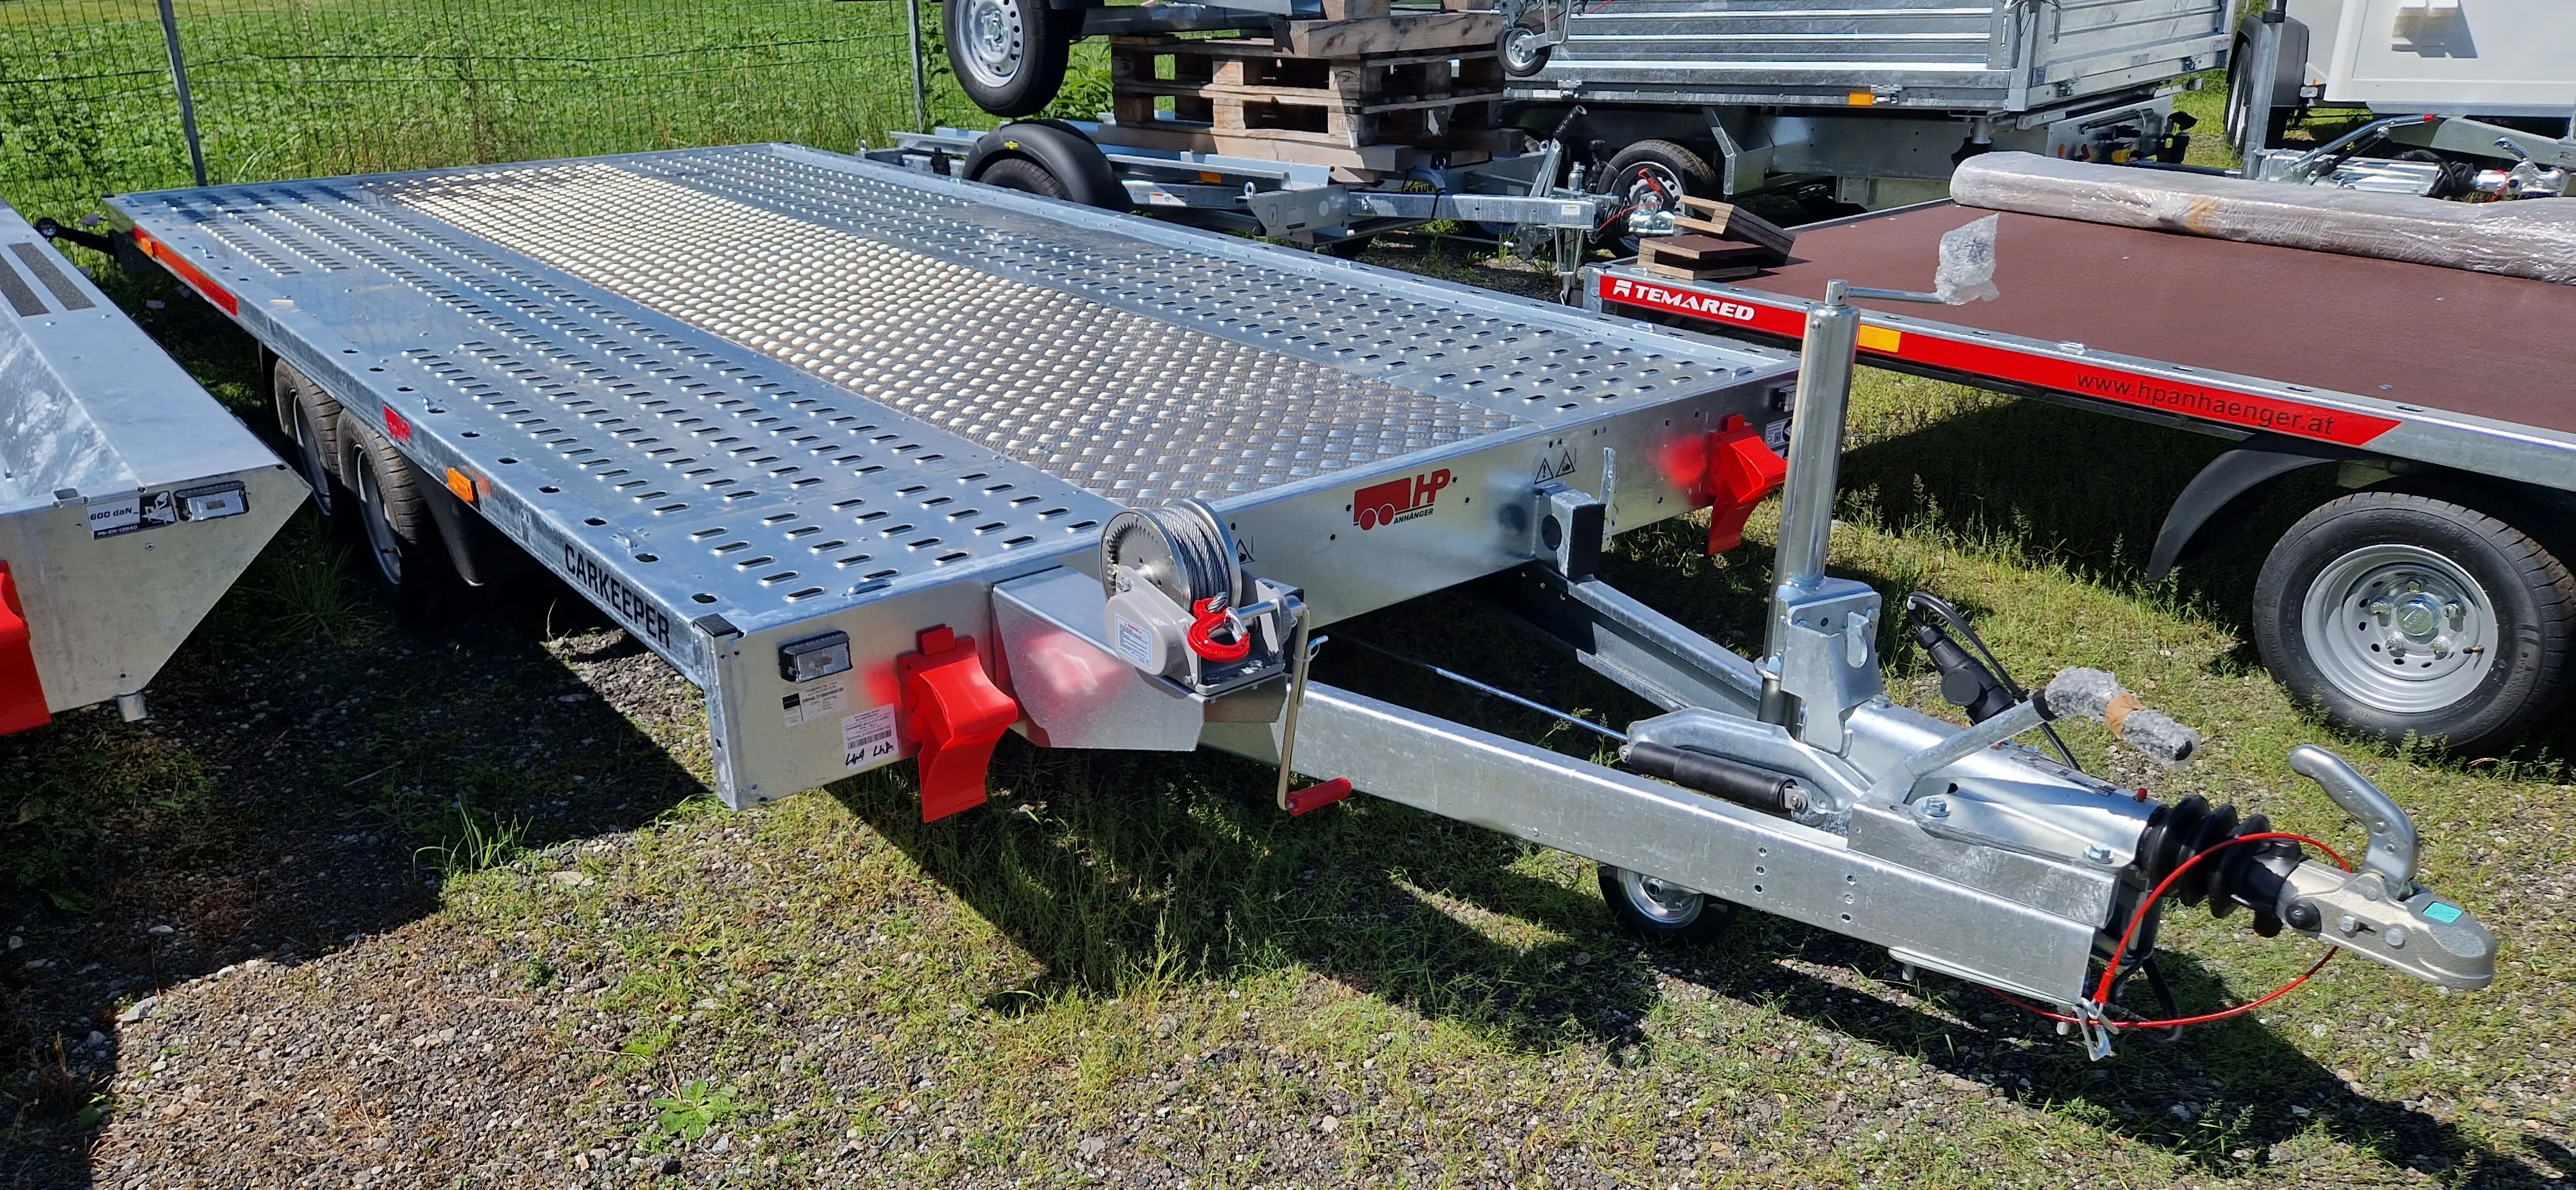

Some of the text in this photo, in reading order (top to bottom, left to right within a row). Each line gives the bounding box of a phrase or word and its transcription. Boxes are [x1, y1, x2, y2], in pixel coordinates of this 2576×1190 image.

[1635, 285, 1755, 321] TEMARED
[2076, 373, 2334, 436] www.hpanhaenger.at
[1412, 468, 1451, 507] HP
[90, 507, 133, 520] 600 daN
[1393, 507, 1434, 525] ANHÄNGER
[565, 543, 670, 649] CARKEEPER
